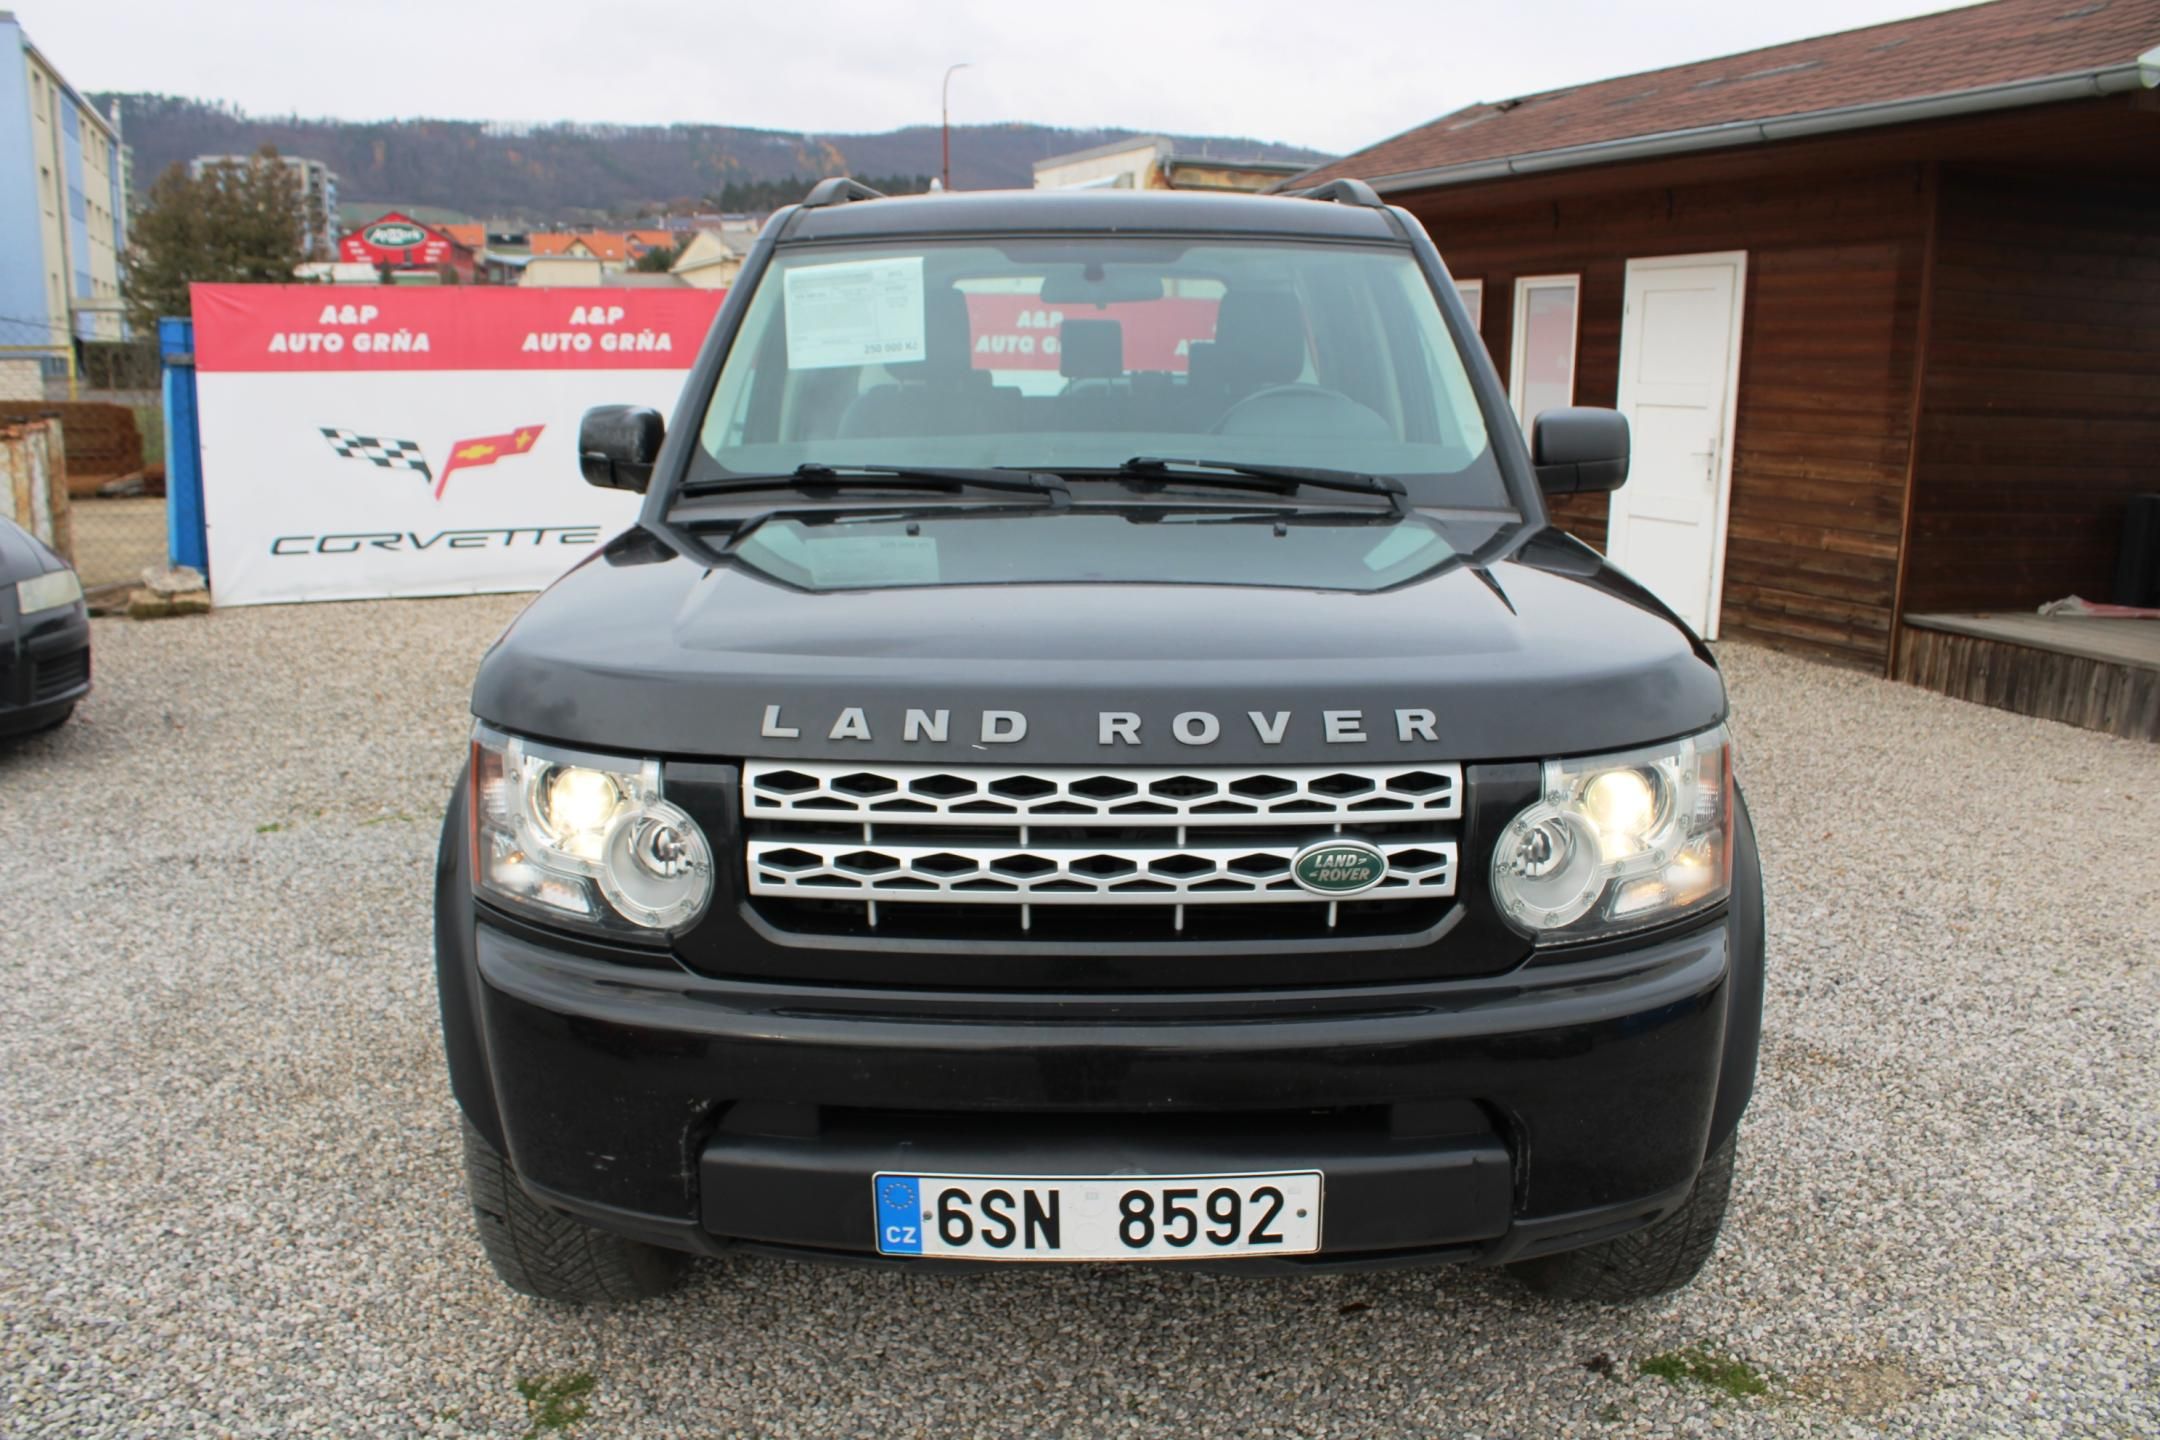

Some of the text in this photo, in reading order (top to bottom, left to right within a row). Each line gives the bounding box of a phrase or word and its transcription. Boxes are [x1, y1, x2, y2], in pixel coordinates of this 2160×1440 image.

[318, 304, 379, 325] A&P
[568, 305, 625, 325] A&P
[1016, 310, 1063, 328] A&P
[268, 332, 345, 352] AUTO
[521, 332, 592, 352] AUTO
[975, 335, 1035, 354] AUTO
[270, 525, 603, 555] CORVETTE
[761, 703, 1439, 745] LAND ROVER
[1314, 854, 1357, 868] LAND
[1318, 867, 1370, 881] ROVER
[937, 1186, 1285, 1249] 6SN 8592
[886, 1225, 917, 1244] CZ
